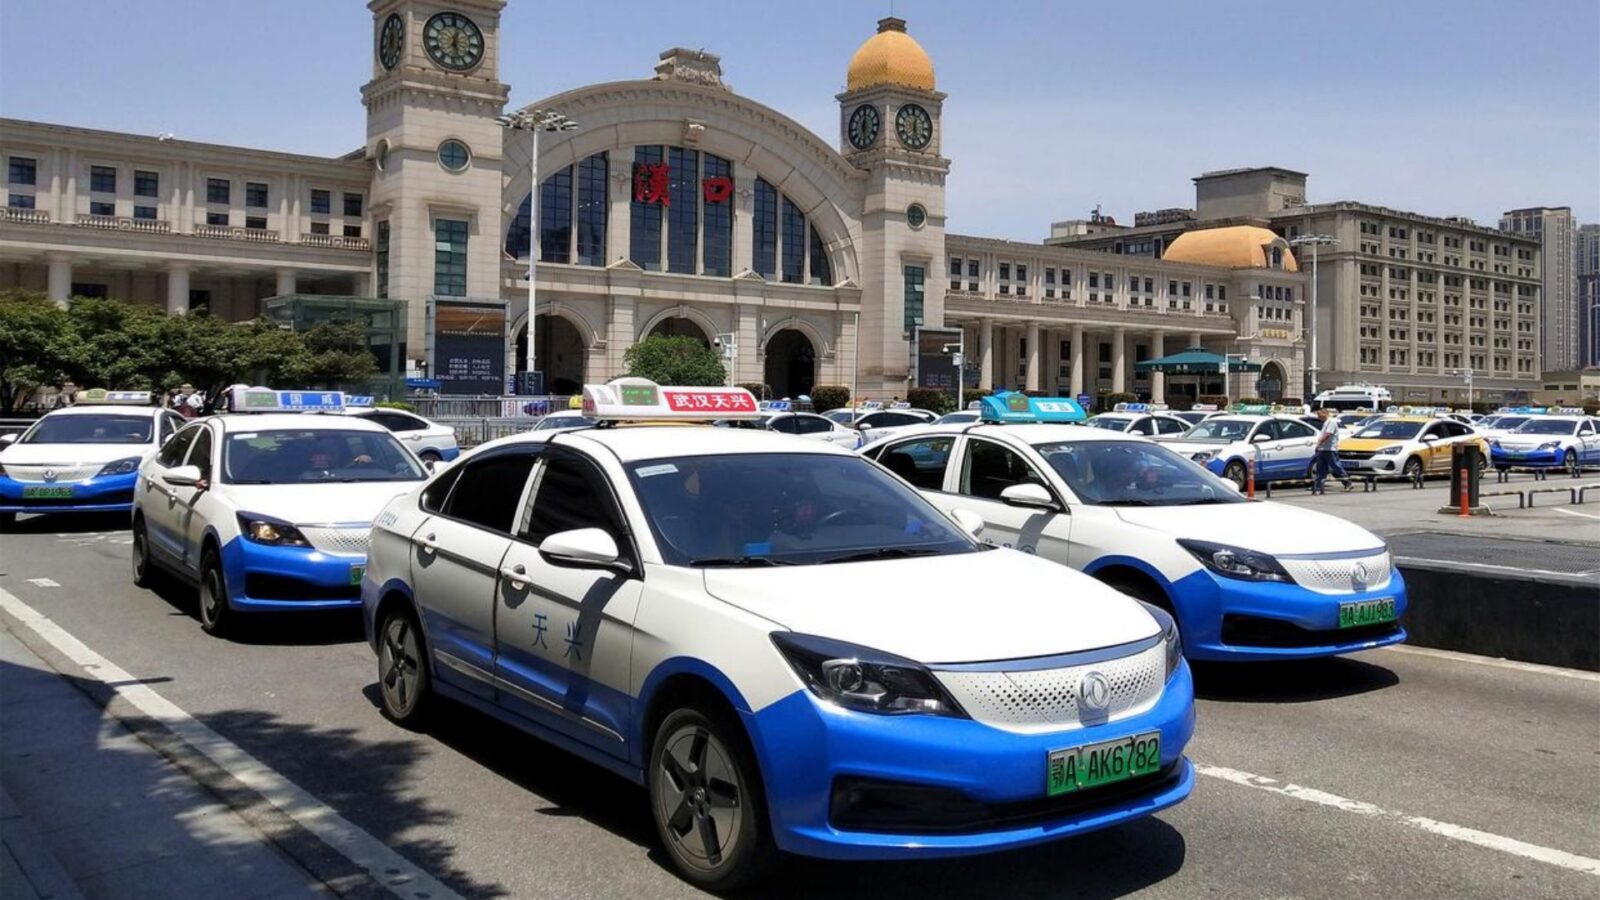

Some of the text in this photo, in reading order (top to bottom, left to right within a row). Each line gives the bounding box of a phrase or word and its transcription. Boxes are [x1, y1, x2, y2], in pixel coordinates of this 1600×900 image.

[672, 393, 749, 408] 武汉天兴
[531, 613, 583, 661] 天兴
